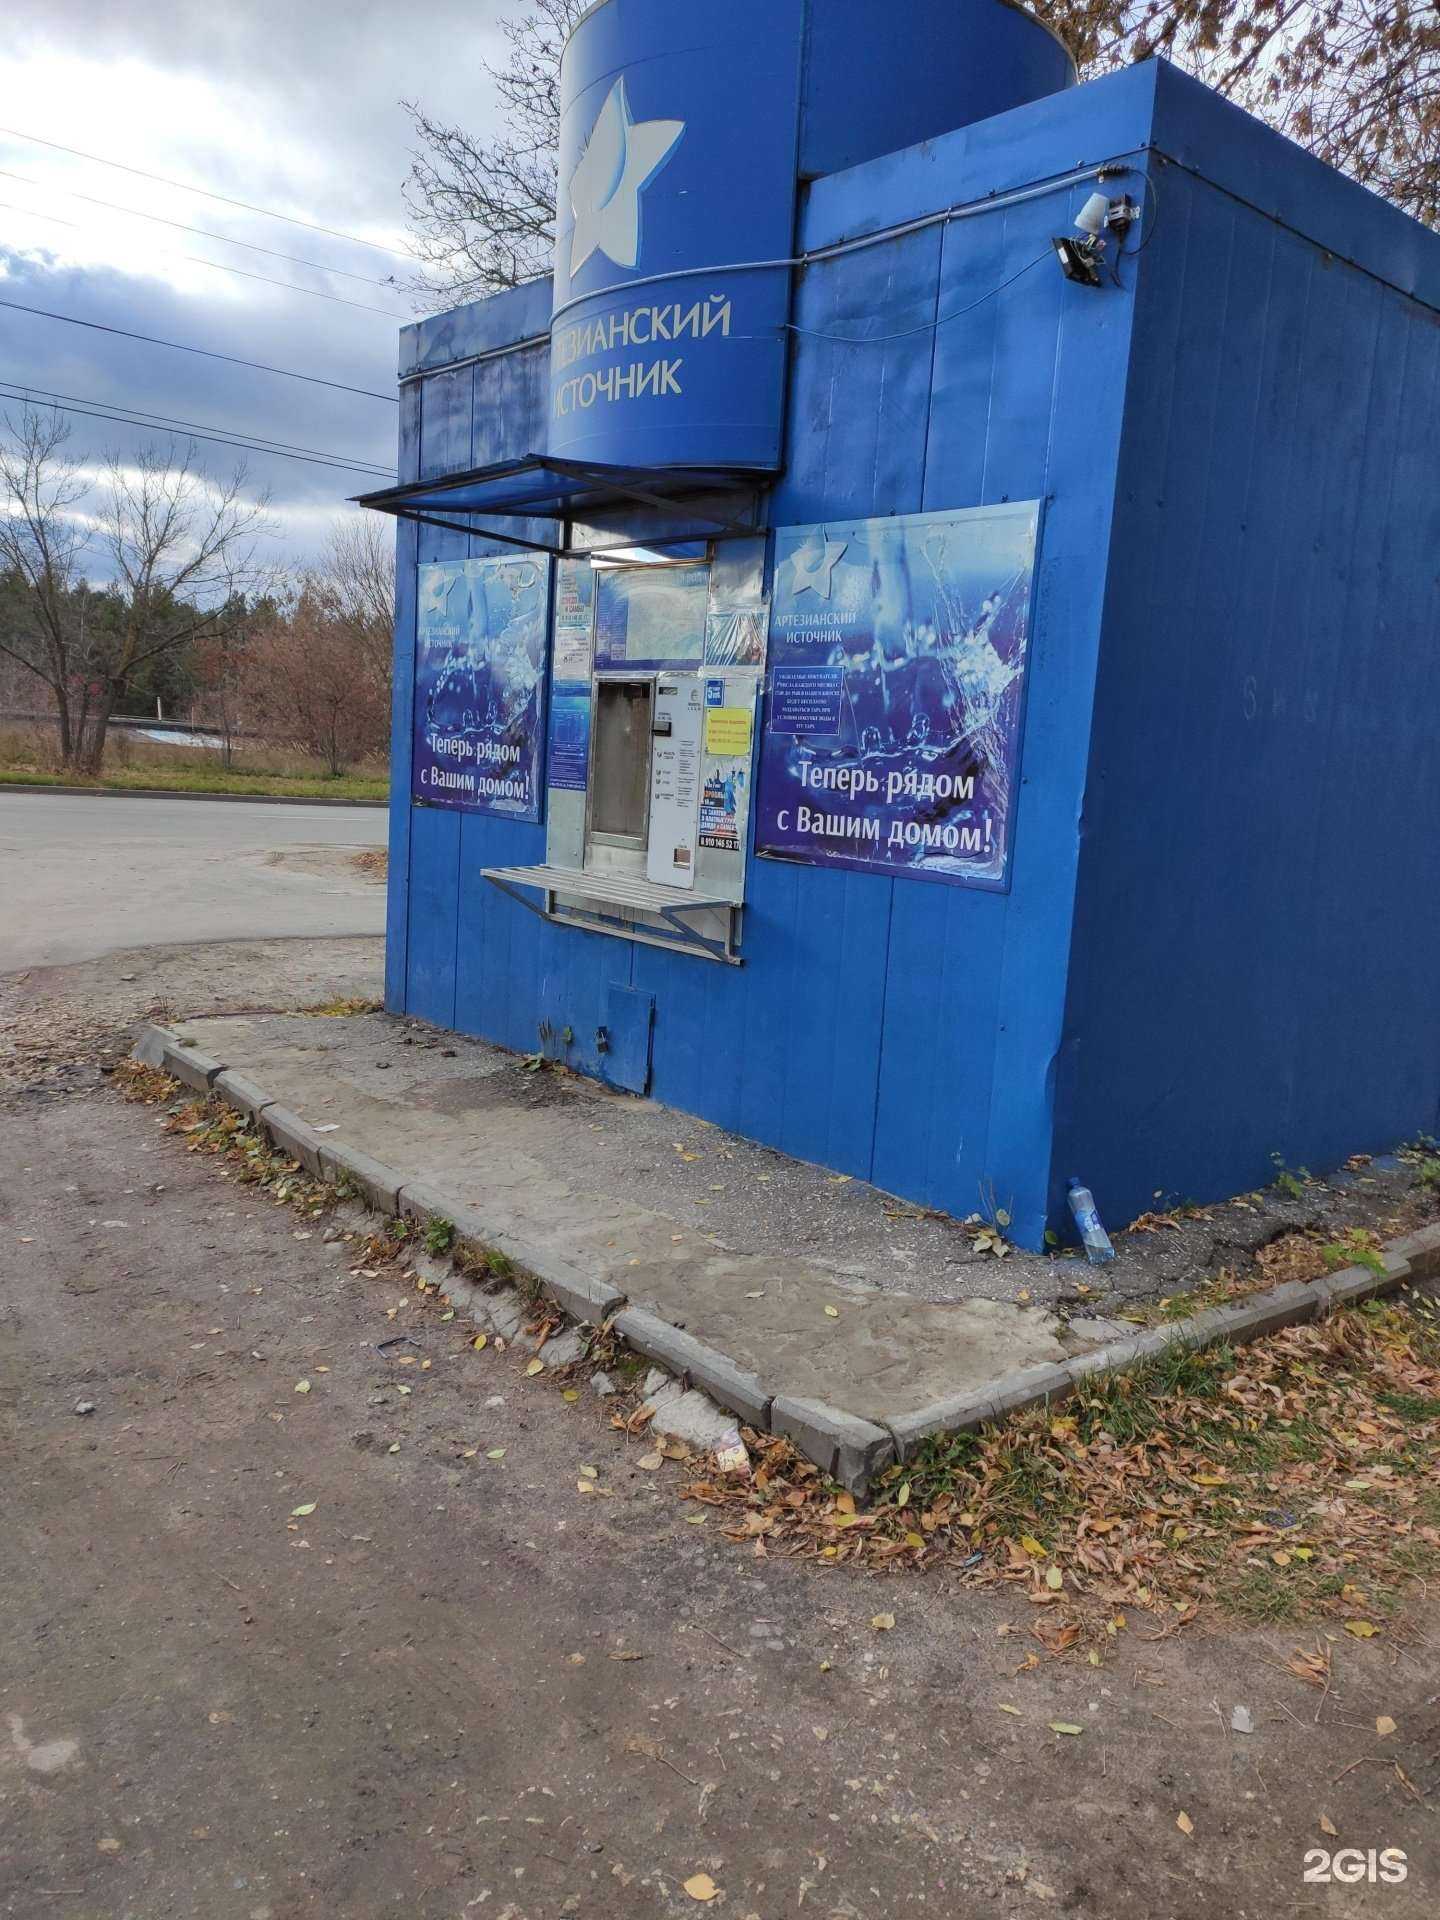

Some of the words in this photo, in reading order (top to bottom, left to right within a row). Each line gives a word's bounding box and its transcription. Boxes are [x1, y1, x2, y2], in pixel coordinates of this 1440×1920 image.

[774, 607, 857, 627] АРТЕЗИАНСКИЙ
[786, 629, 843, 644] ИСТОЧНИК
[431, 733, 473, 763] Теперь
[476, 740, 521, 765] рядом
[421, 768, 428, 784] с
[430, 766, 475, 792] Вашим
[477, 770, 530, 800] домом!
[798, 760, 880, 801] Теперь
[886, 767, 975, 804] рядом
[776, 810, 790, 831] с
[796, 806, 880, 841] Вашим
[887, 818, 993, 853] домом!
